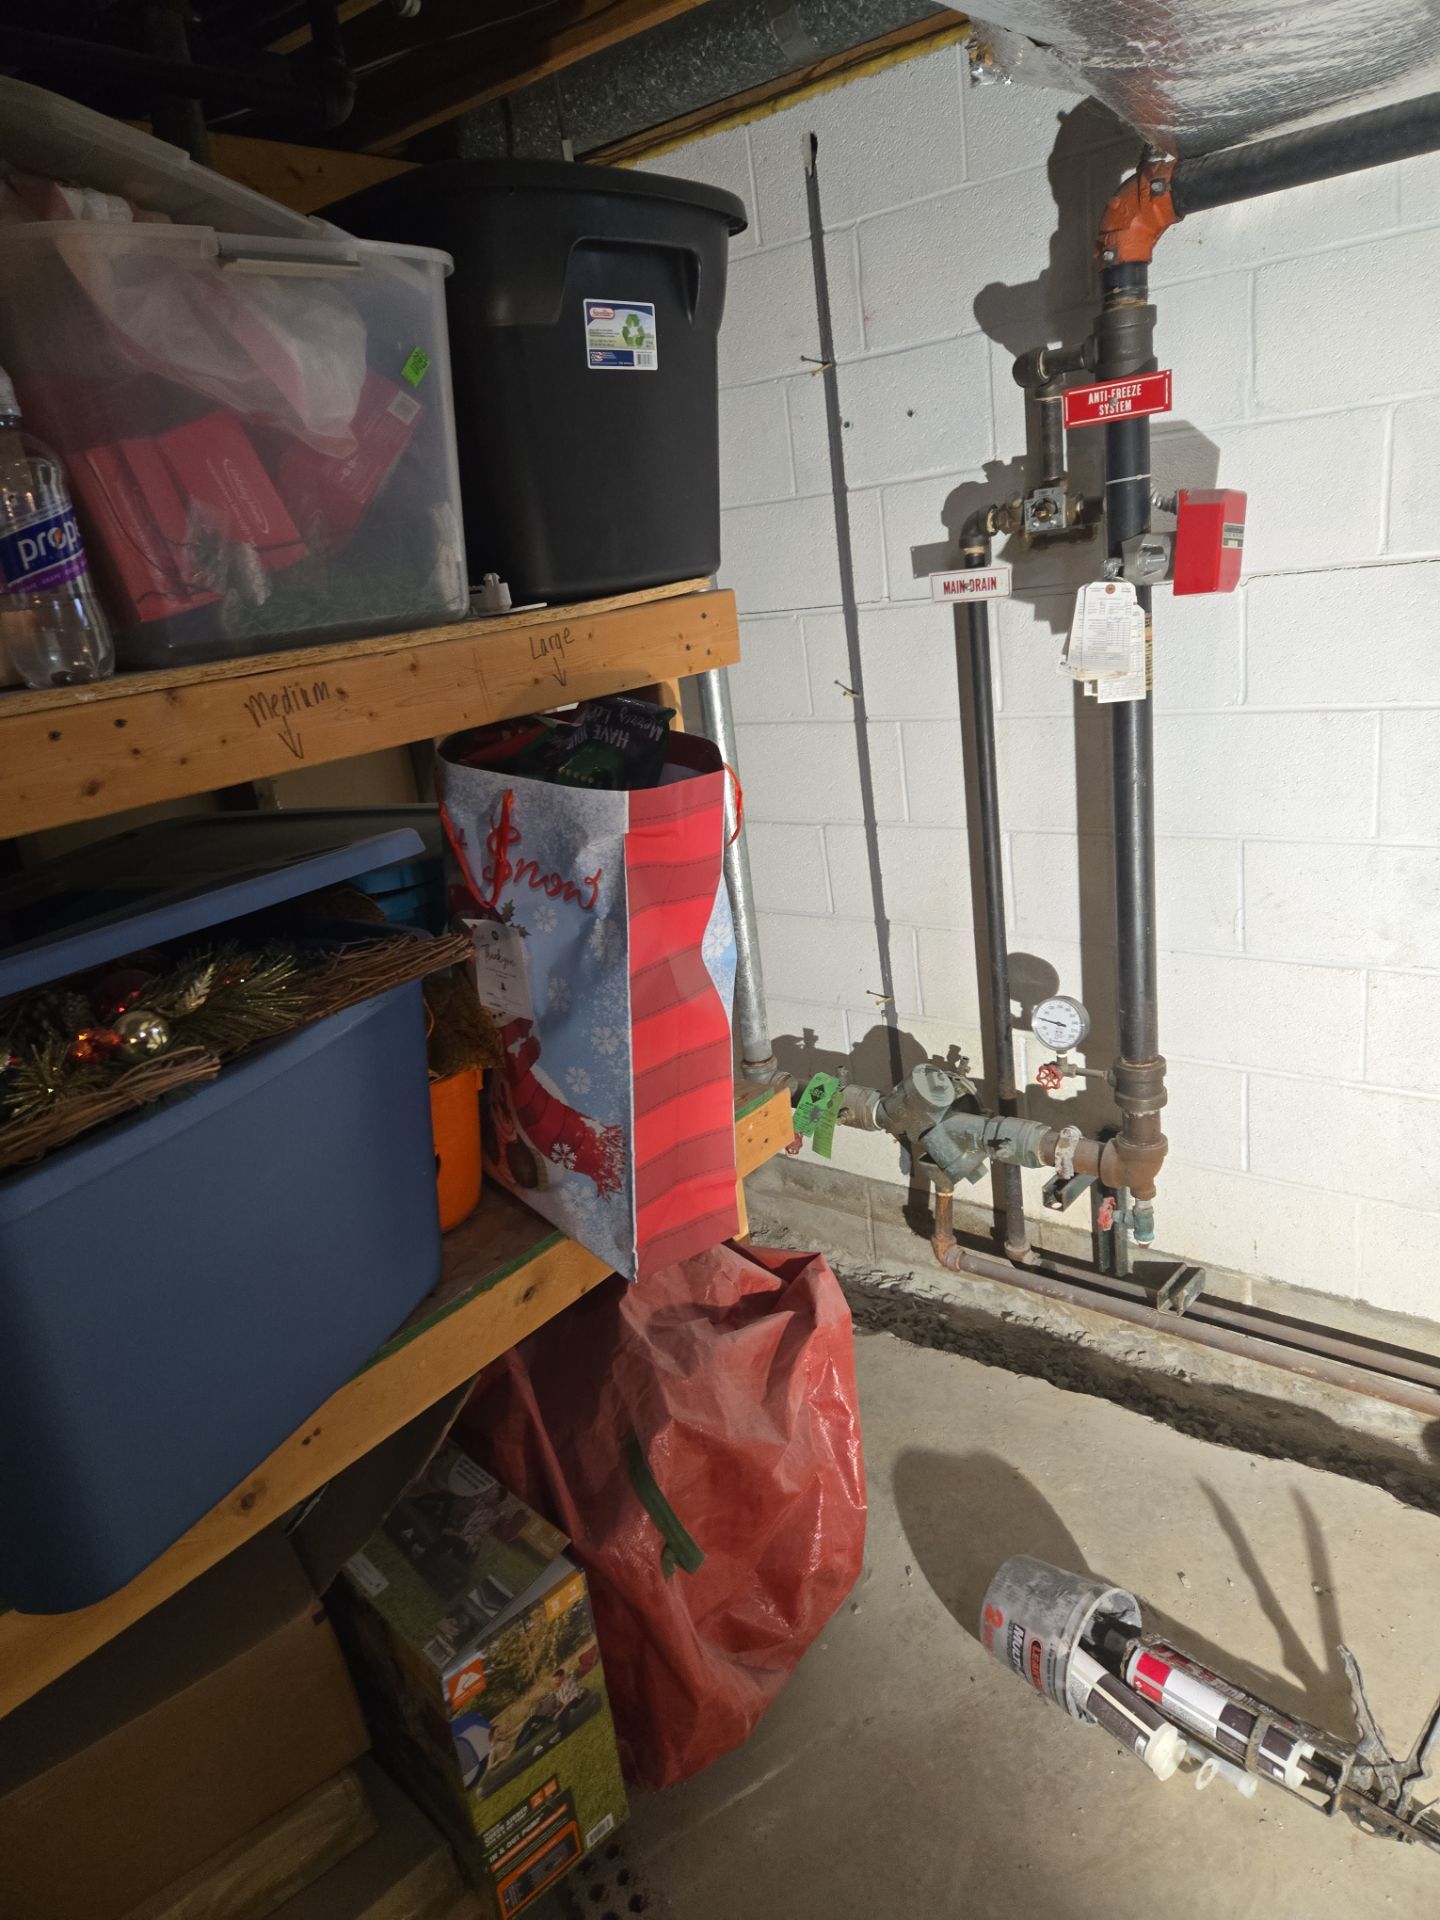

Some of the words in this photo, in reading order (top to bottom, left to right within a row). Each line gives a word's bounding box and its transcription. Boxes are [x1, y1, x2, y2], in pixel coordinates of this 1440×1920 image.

[1087, 383, 1142, 406] ANTI-FREEZE
[1098, 399, 1132, 416] SYSTEM
[16, 516, 81, 571] prop
[943, 580, 966, 595] MAIN
[968, 576, 997, 593] DRAIN
[529, 626, 575, 660] Large
[243, 680, 331, 729] Medium
